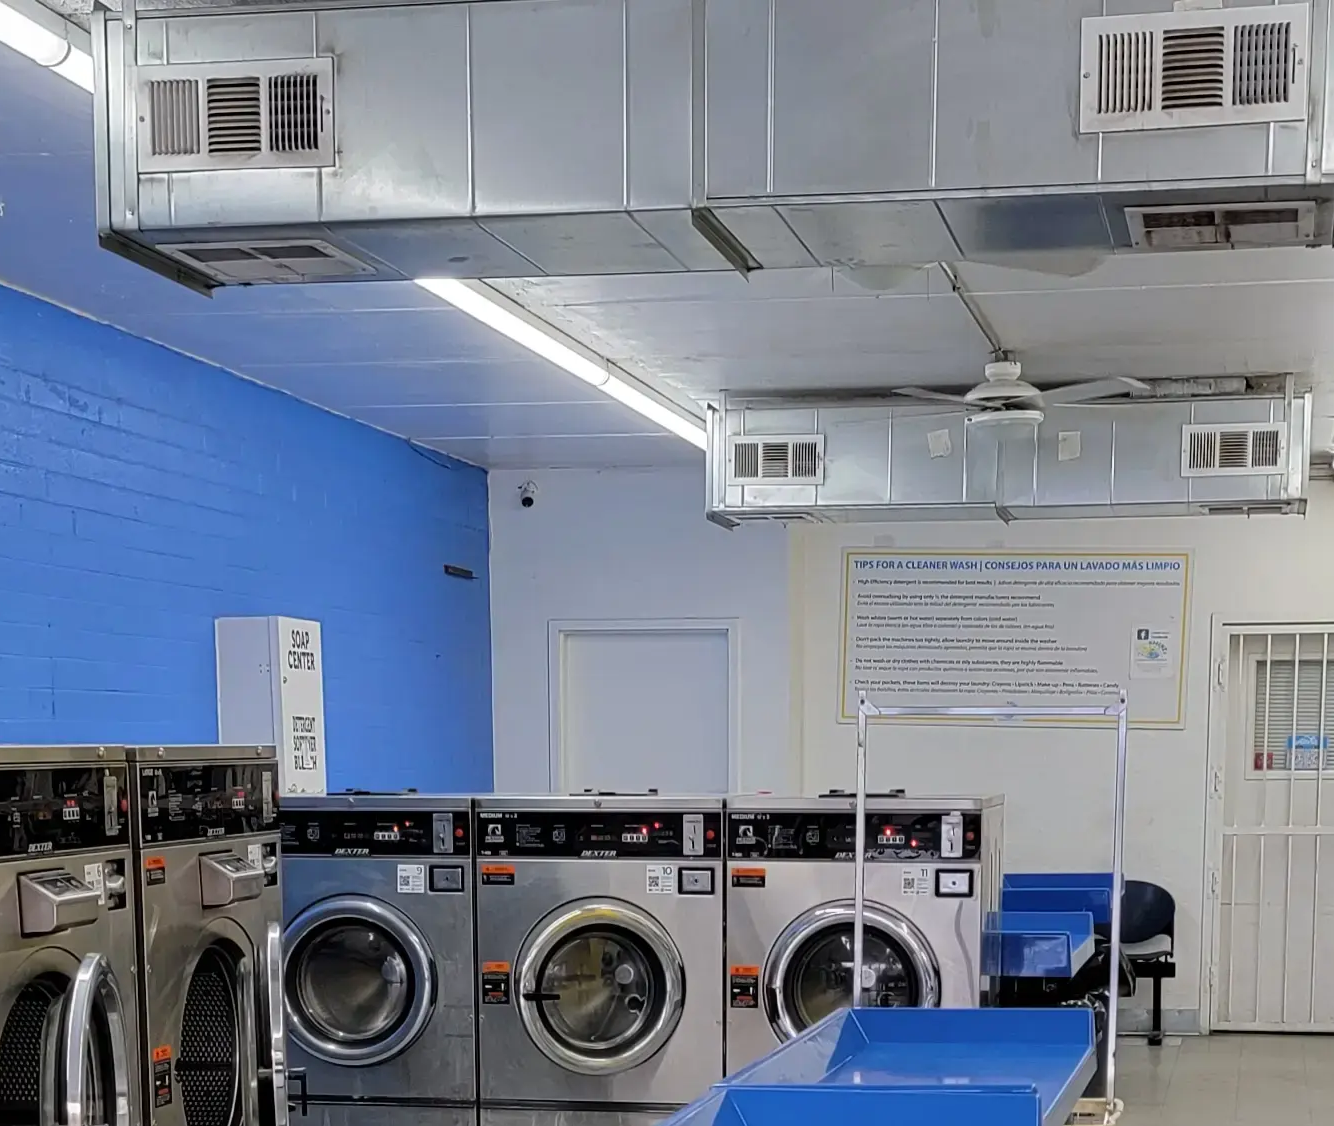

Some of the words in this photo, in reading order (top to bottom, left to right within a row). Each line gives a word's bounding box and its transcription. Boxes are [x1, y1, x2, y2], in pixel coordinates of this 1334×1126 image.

[854, 560, 874, 570] TIPS
[876, 561, 895, 570] FOR
[897, 561, 904, 570] A
[905, 561, 948, 570] CLEANER
[950, 561, 977, 570] WASH
[985, 561, 1034, 571] CONSEJOS
[1036, 561, 1061, 570] PARA
[1064, 562, 1078, 570] UN
[1080, 562, 1120, 571] LAVADO
[1122, 560, 1144, 571] MÁS
[1146, 562, 1180, 571] LIMPIO
[291, 630, 310, 650] SOAP
[288, 650, 315, 671] CENTER
[292, 716, 315, 733] DETERGENT
[293, 736, 316, 752] SOFNER
[28, 841, 53, 852] DEXTER
[334, 848, 370, 856] DEXTER
[97, 865, 102, 878] 6
[416, 866, 423, 875] 9
[662, 866, 672, 876] 10
[921, 868, 928, 877] 11
